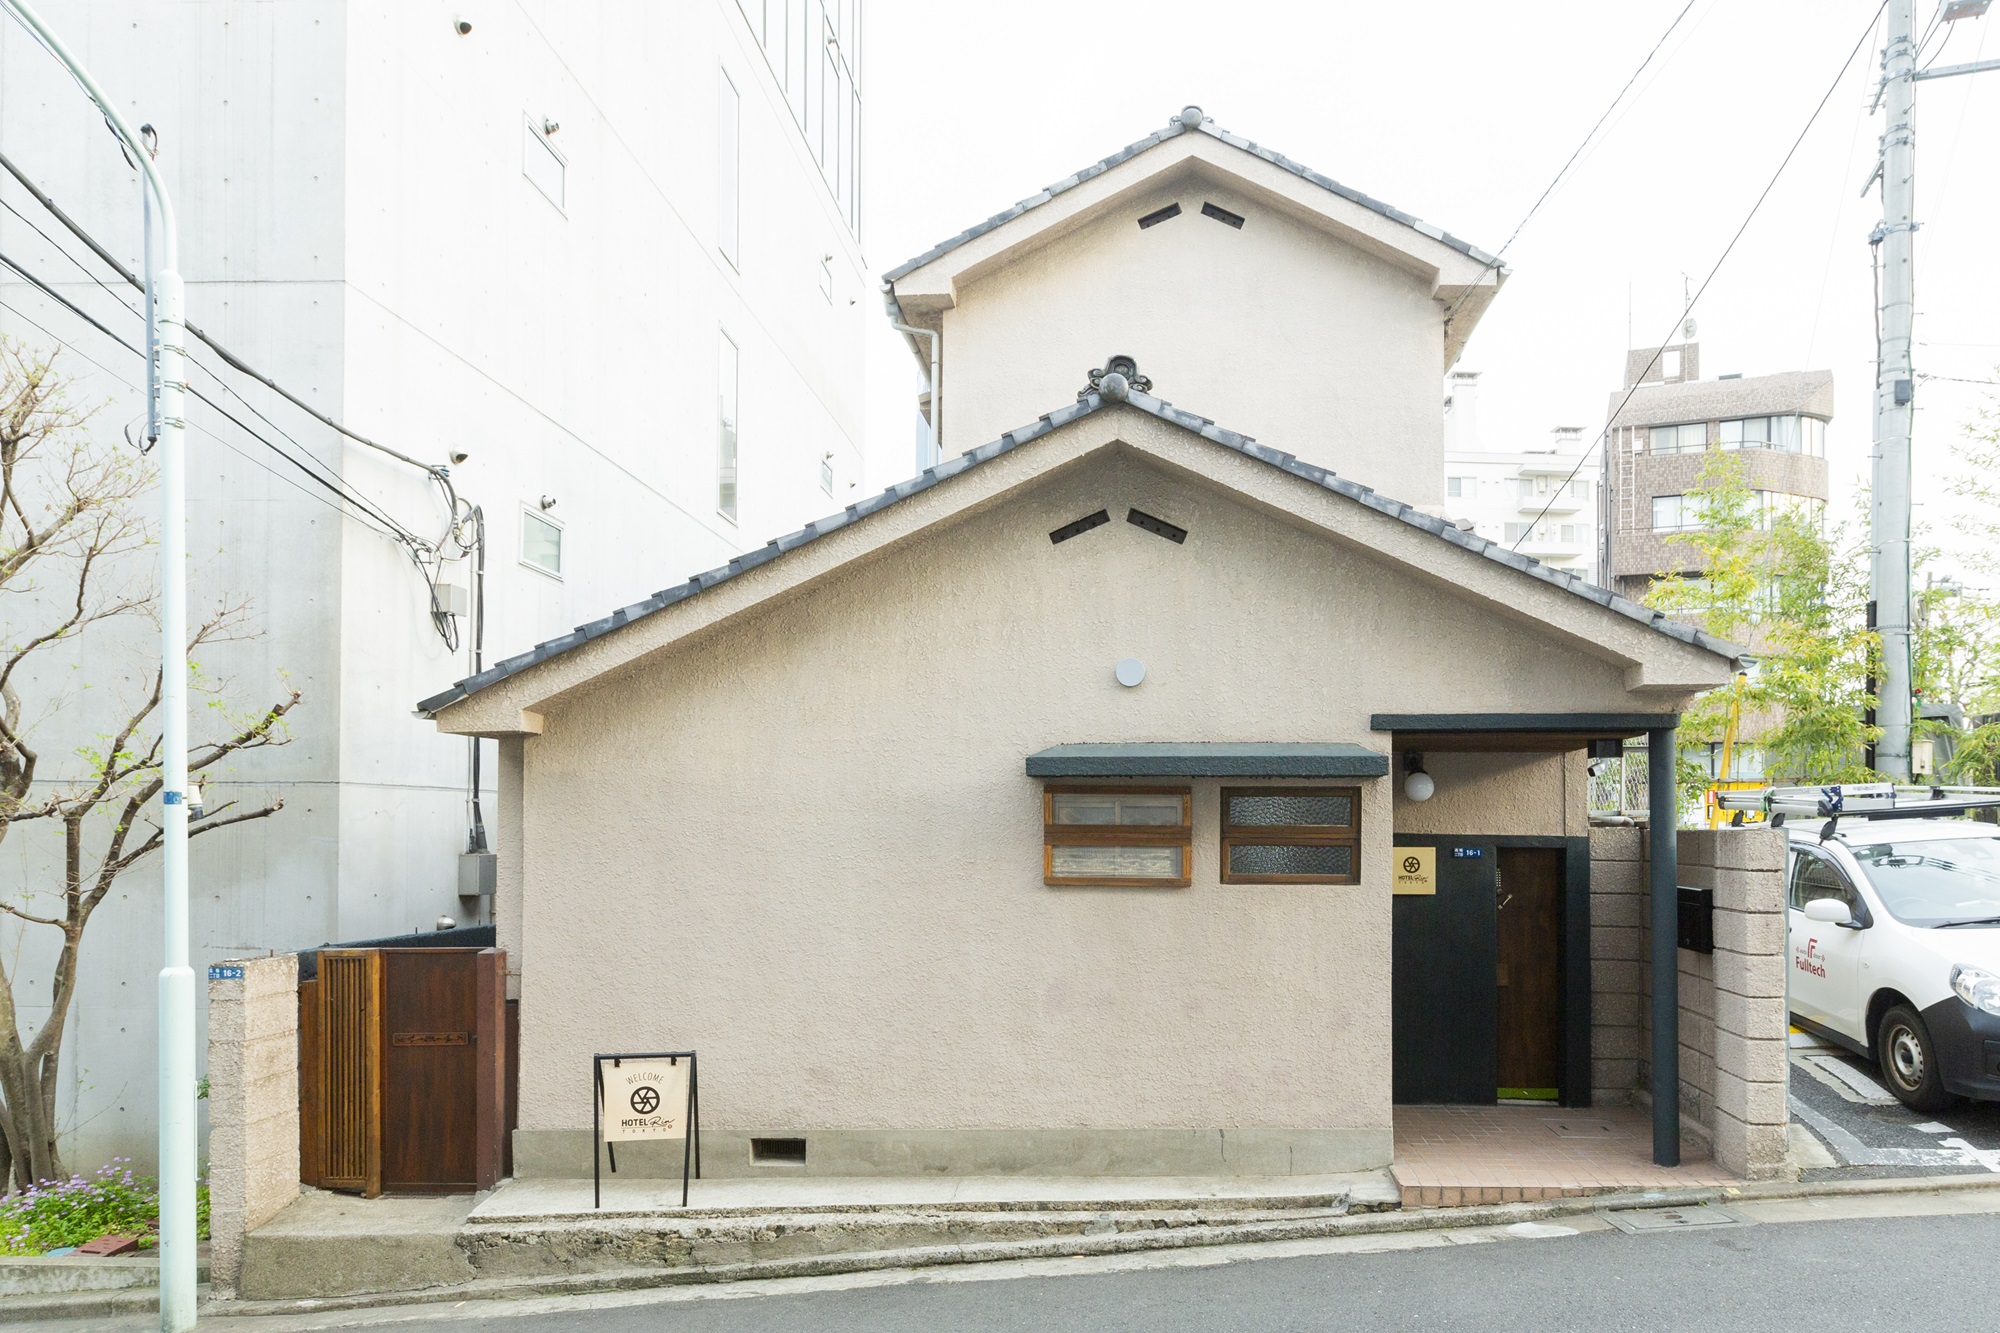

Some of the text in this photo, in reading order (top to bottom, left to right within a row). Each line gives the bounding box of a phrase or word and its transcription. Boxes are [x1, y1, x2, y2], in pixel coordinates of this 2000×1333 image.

[1795, 955, 1826, 979] Fulltech
[223, 969, 241, 977] 16-2
[625, 1072, 665, 1085] WELCOME
[621, 1118, 648, 1127] HOTEL
